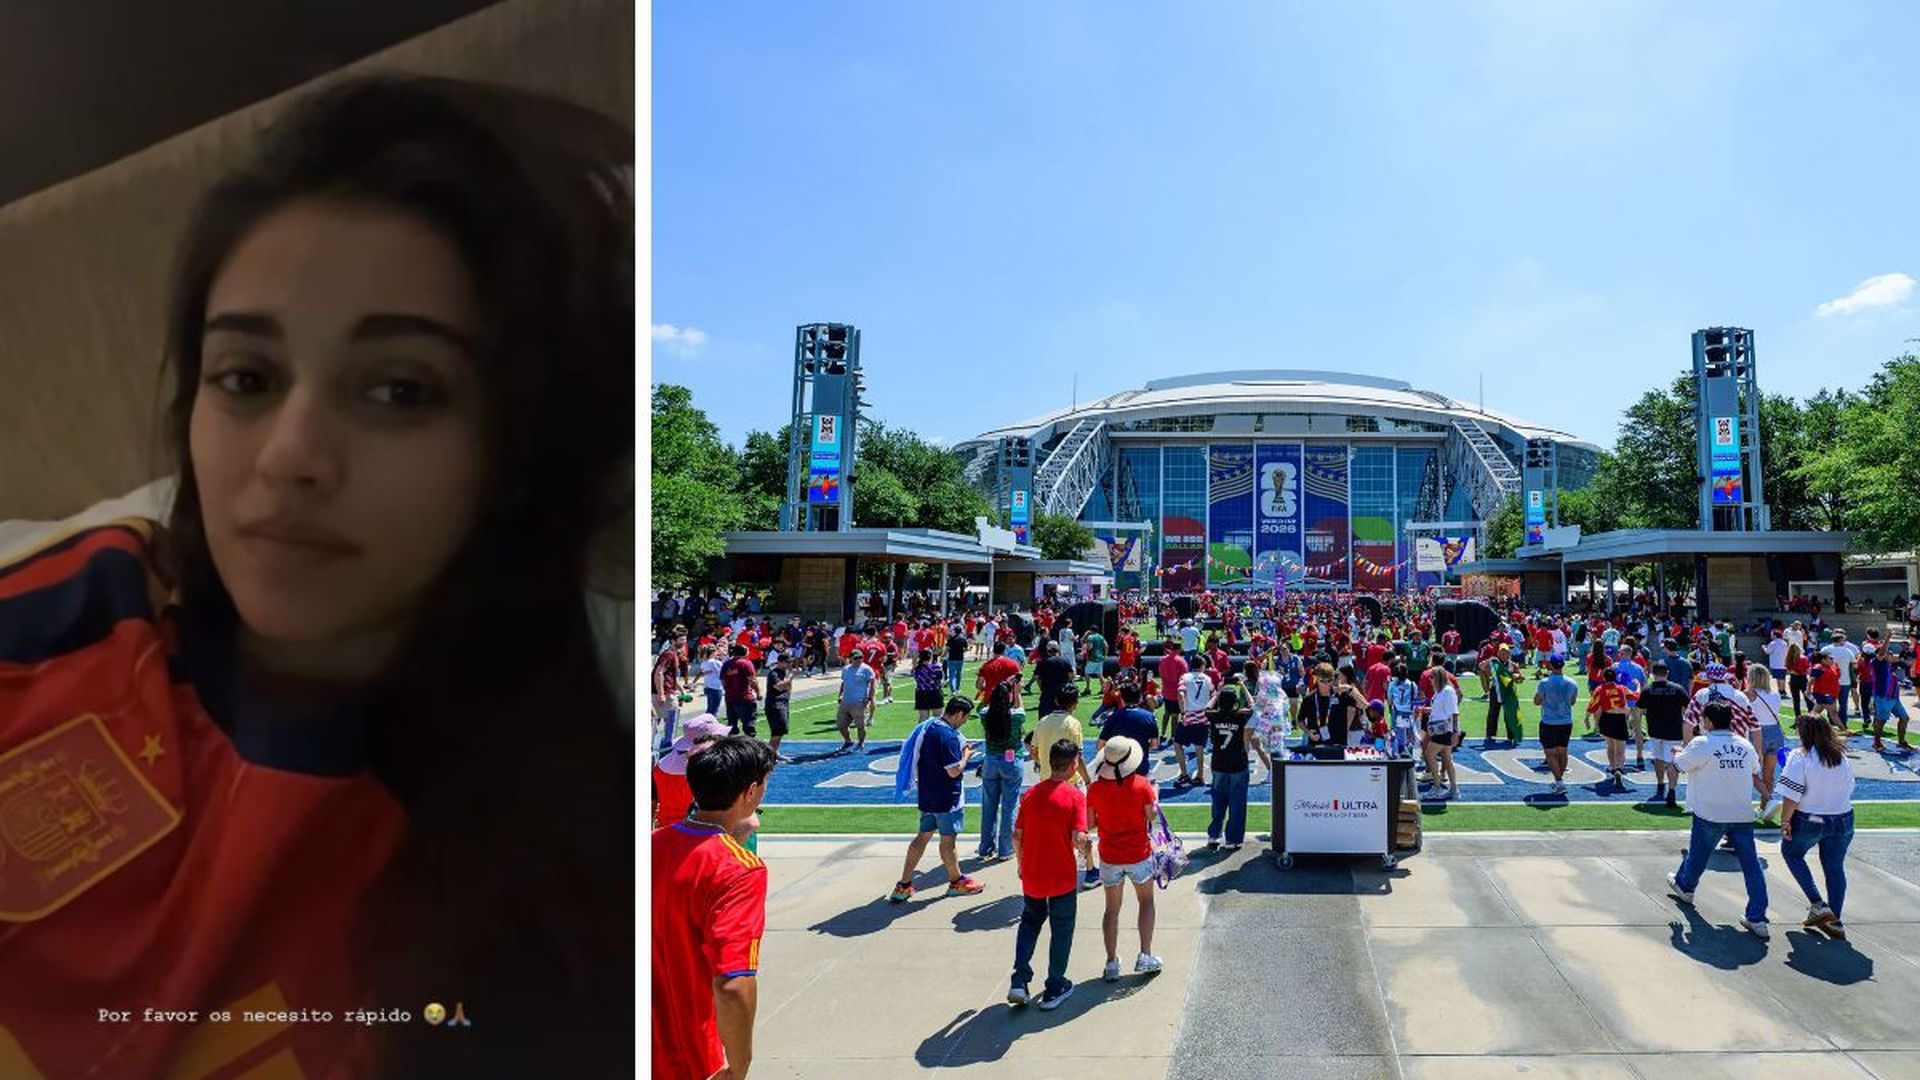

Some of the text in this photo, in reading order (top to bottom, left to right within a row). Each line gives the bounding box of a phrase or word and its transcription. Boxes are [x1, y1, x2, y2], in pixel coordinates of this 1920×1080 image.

[1261, 524, 1297, 534] 2026
[867, 648, 878, 663] 7
[1195, 681, 1204, 700] 7
[1219, 729, 1233, 750] 7
[1719, 759, 1744, 769] STATE
[1341, 800, 1378, 810] ULTRA
